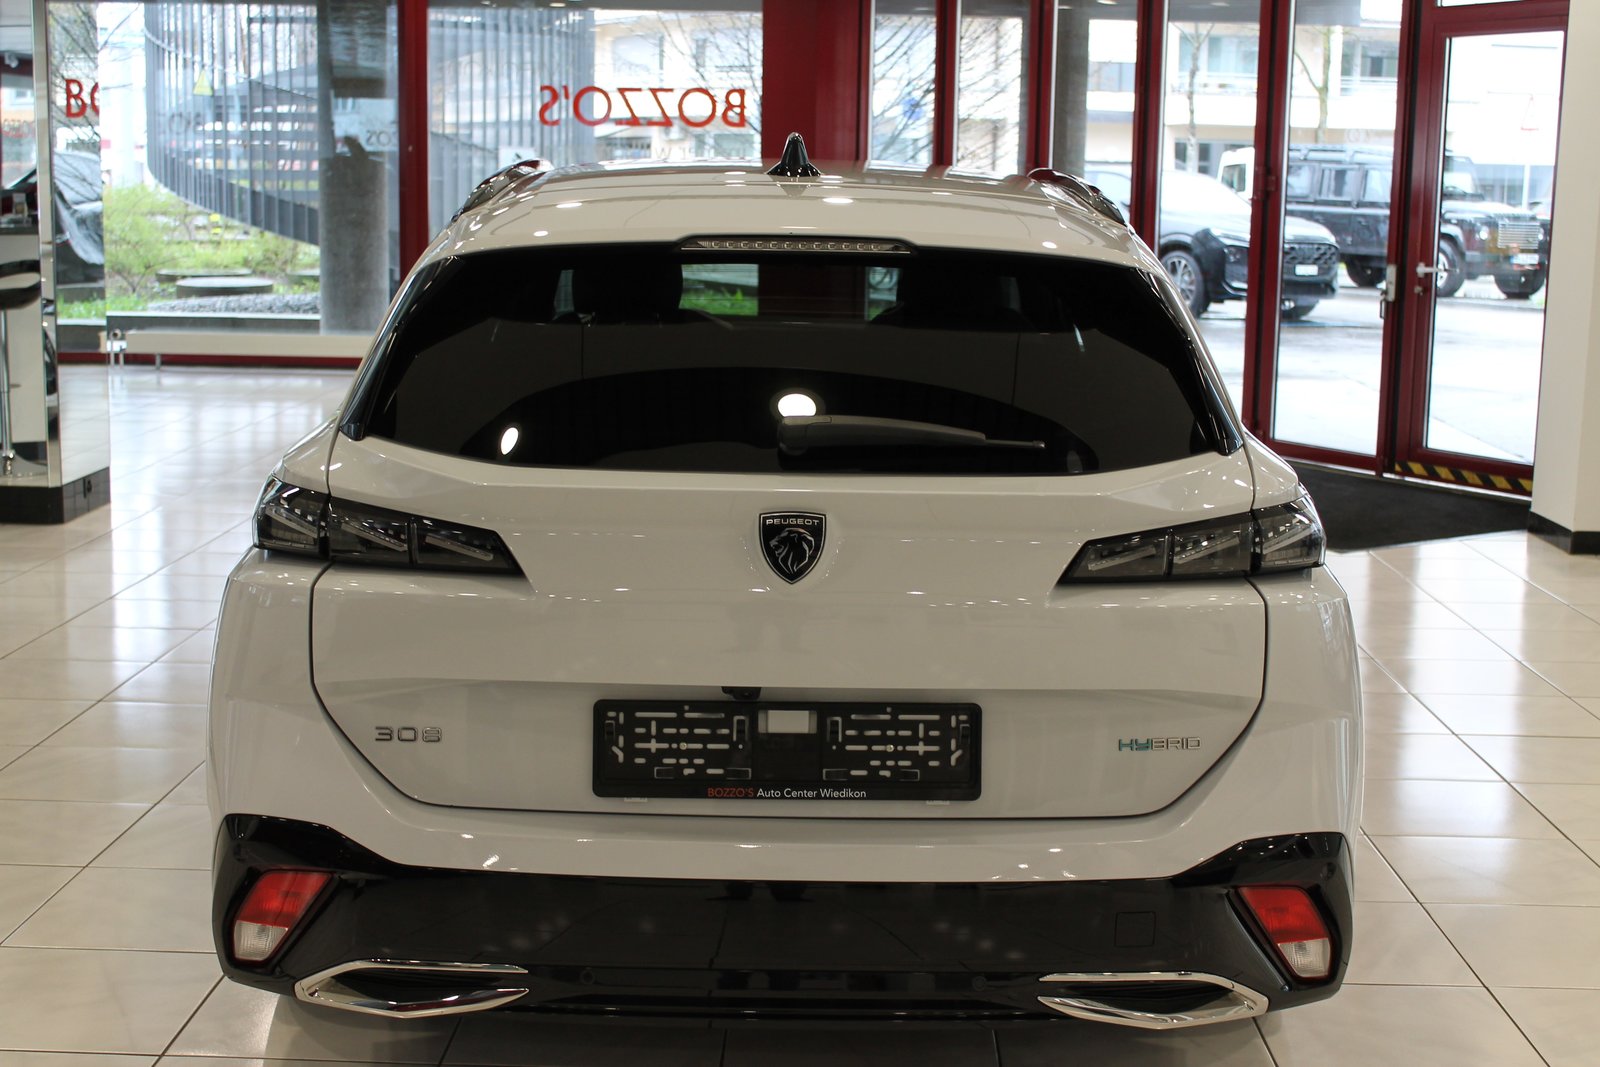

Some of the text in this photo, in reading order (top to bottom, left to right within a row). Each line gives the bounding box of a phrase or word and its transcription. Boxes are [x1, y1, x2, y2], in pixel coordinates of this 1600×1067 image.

[765, 517, 820, 526] PEUGEOT
[374, 726, 443, 743] 308
[1118, 736, 1202, 752] HYBRID
[707, 787, 867, 798] BOZZO'S Auto Center Wiedikon
